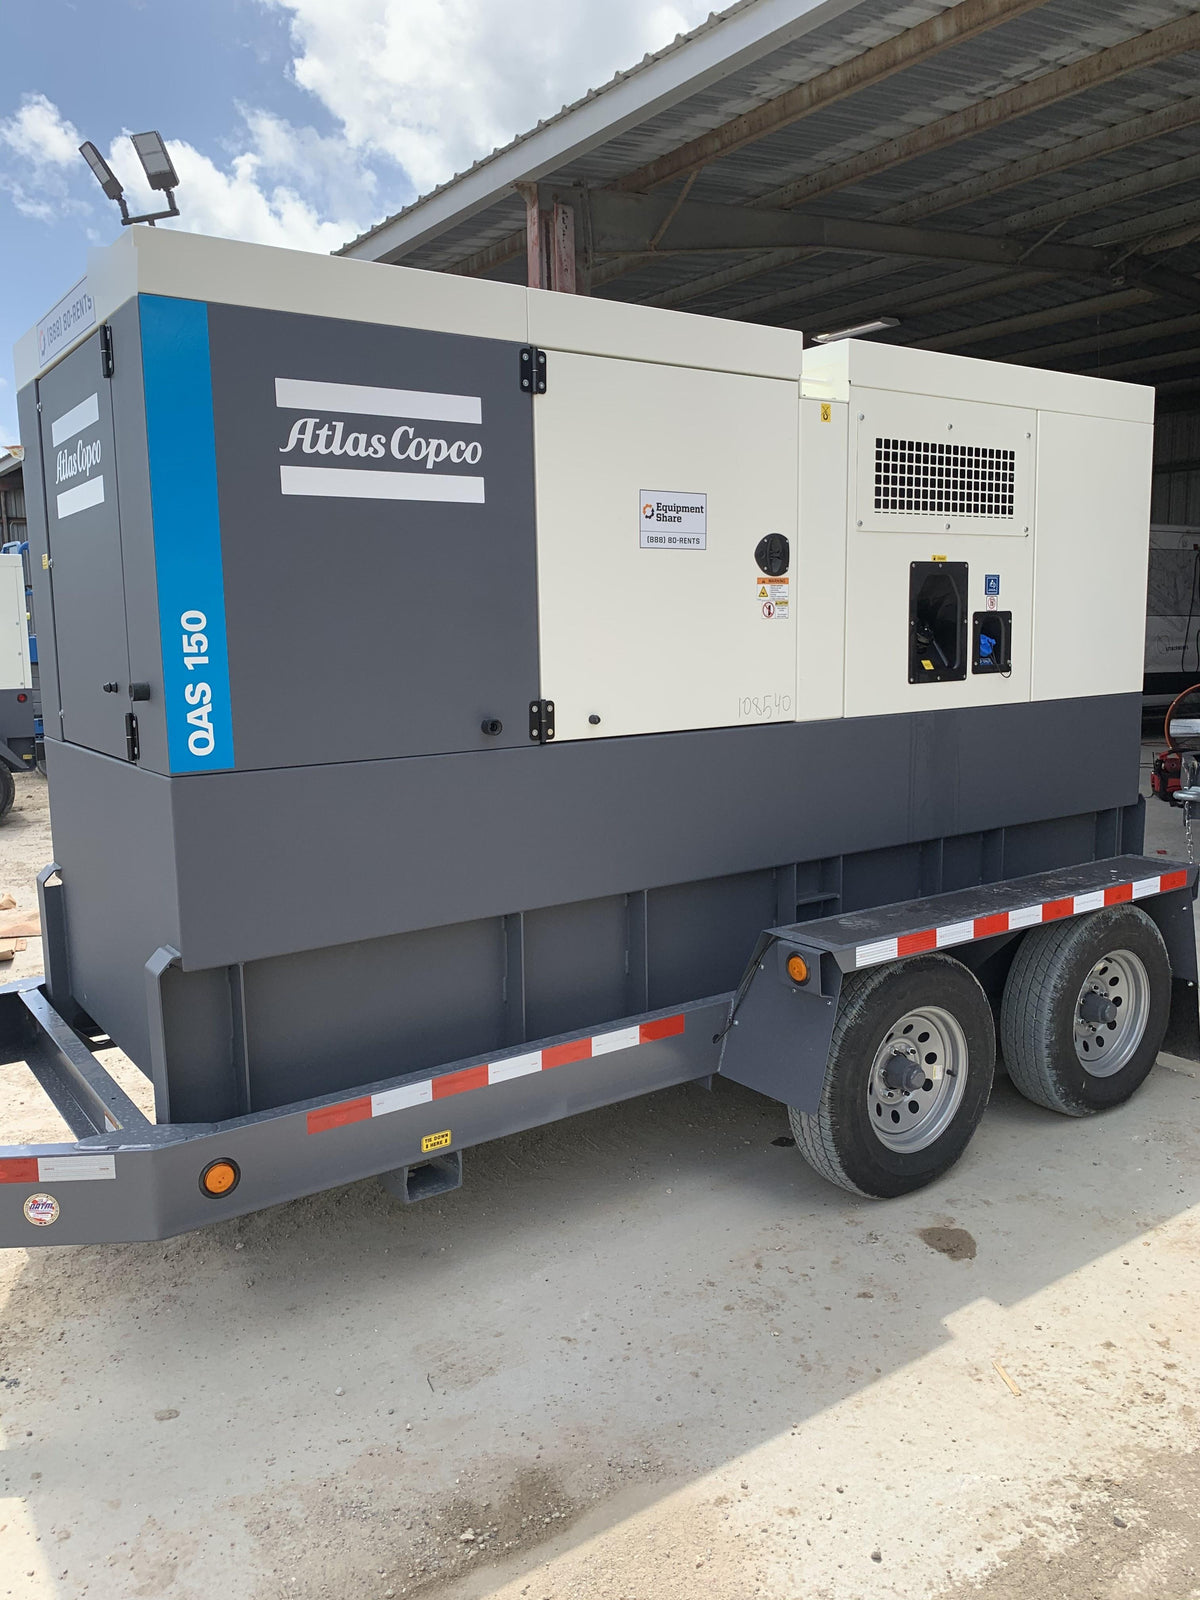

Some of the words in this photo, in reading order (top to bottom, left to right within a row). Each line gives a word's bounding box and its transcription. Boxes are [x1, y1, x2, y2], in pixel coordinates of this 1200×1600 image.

[47, 316, 62, 346] (888)
[279, 417, 386, 459] Atlas
[390, 425, 482, 469] Copco
[56, 449, 77, 484] Atlas
[77, 439, 101, 476] Copco
[656, 502, 704, 514] Equipment
[656, 513, 682, 523] Share
[646, 535, 666, 544] (888)
[667, 536, 701, 545] 80-RENTS
[180, 610, 209, 670] 150
[185, 682, 215, 756] QAS
[738, 692, 792, 720] 108540
